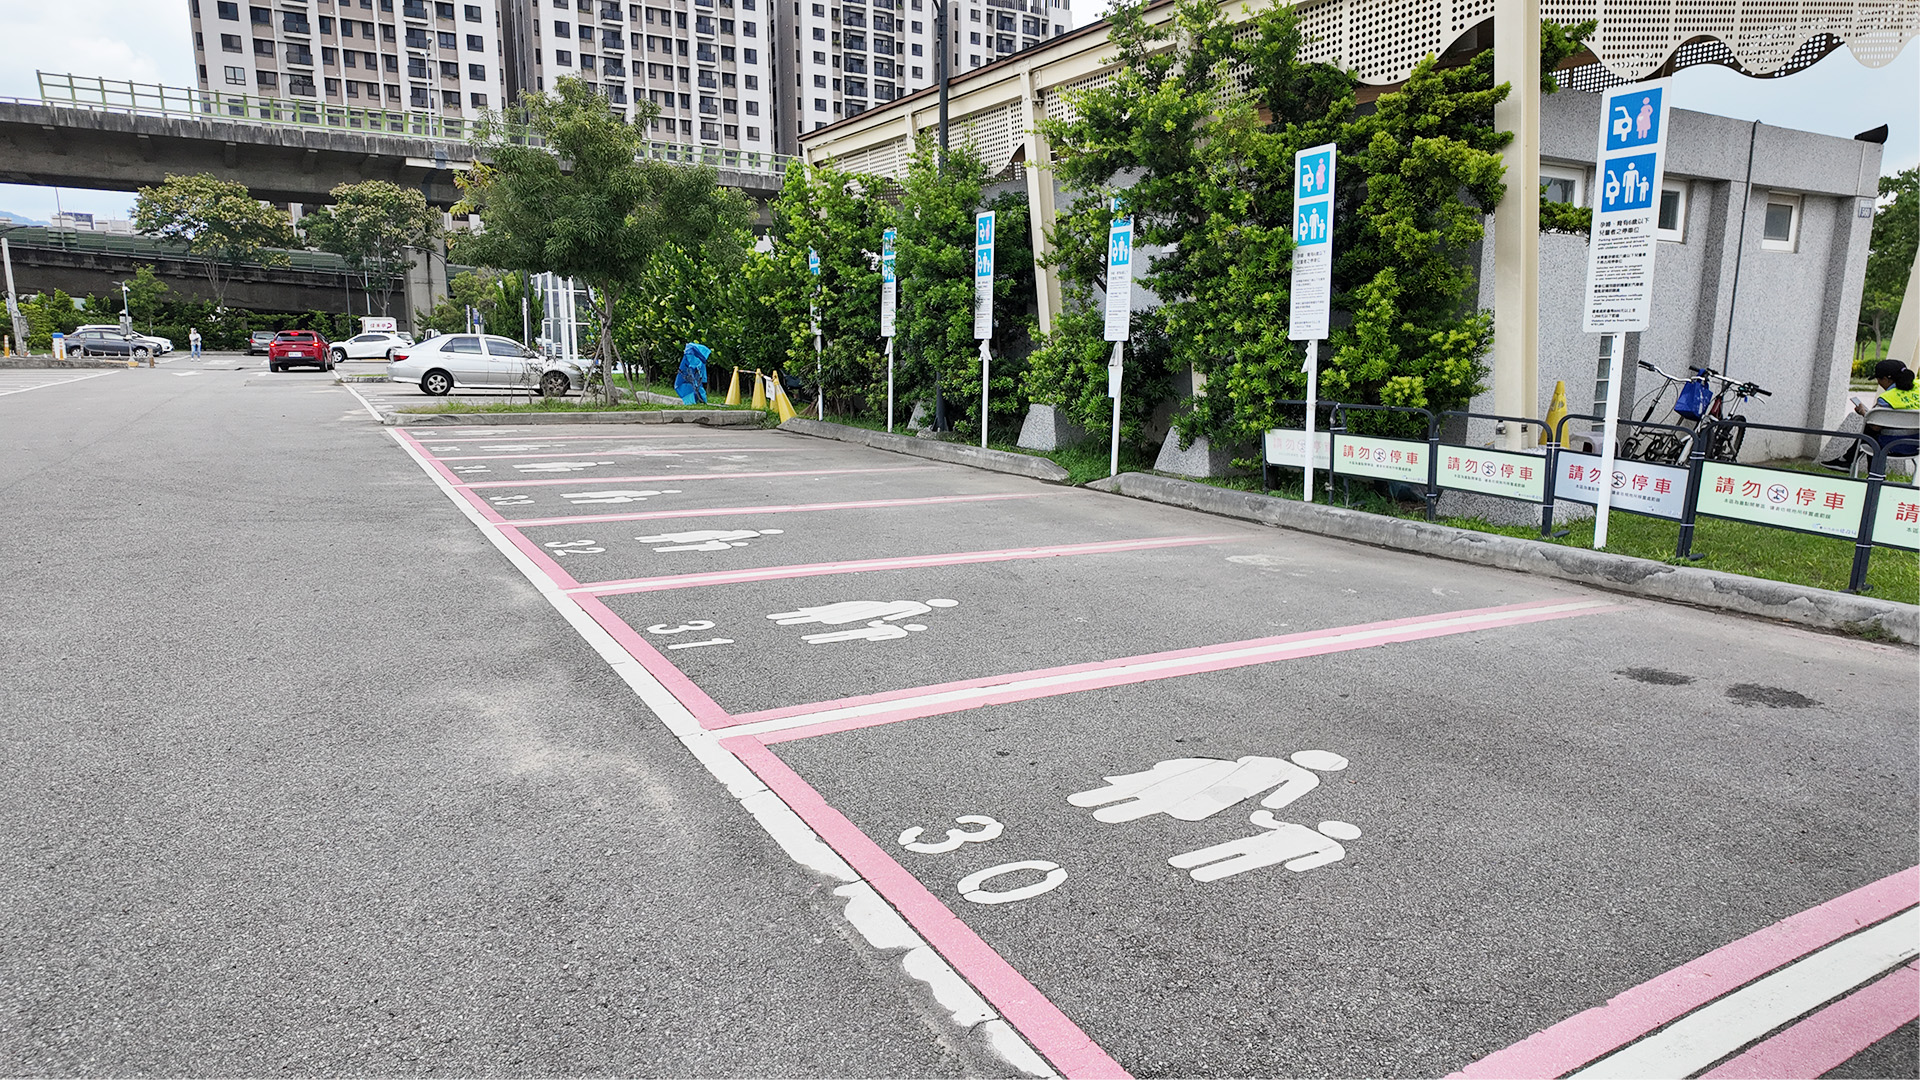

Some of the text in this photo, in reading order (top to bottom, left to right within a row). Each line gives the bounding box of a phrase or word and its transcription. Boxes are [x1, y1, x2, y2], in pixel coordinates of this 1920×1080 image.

[1343, 444, 1419, 465] 請勿 停車
[1448, 456, 1478, 474] 請勿
[1500, 463, 1533, 481] 停車
[1632, 474, 1672, 494] 停車
[1715, 476, 1846, 510] 請勿 停車
[544, 540, 606, 557] 32
[647, 620, 735, 650] 31
[898, 815, 1068, 904] 30
